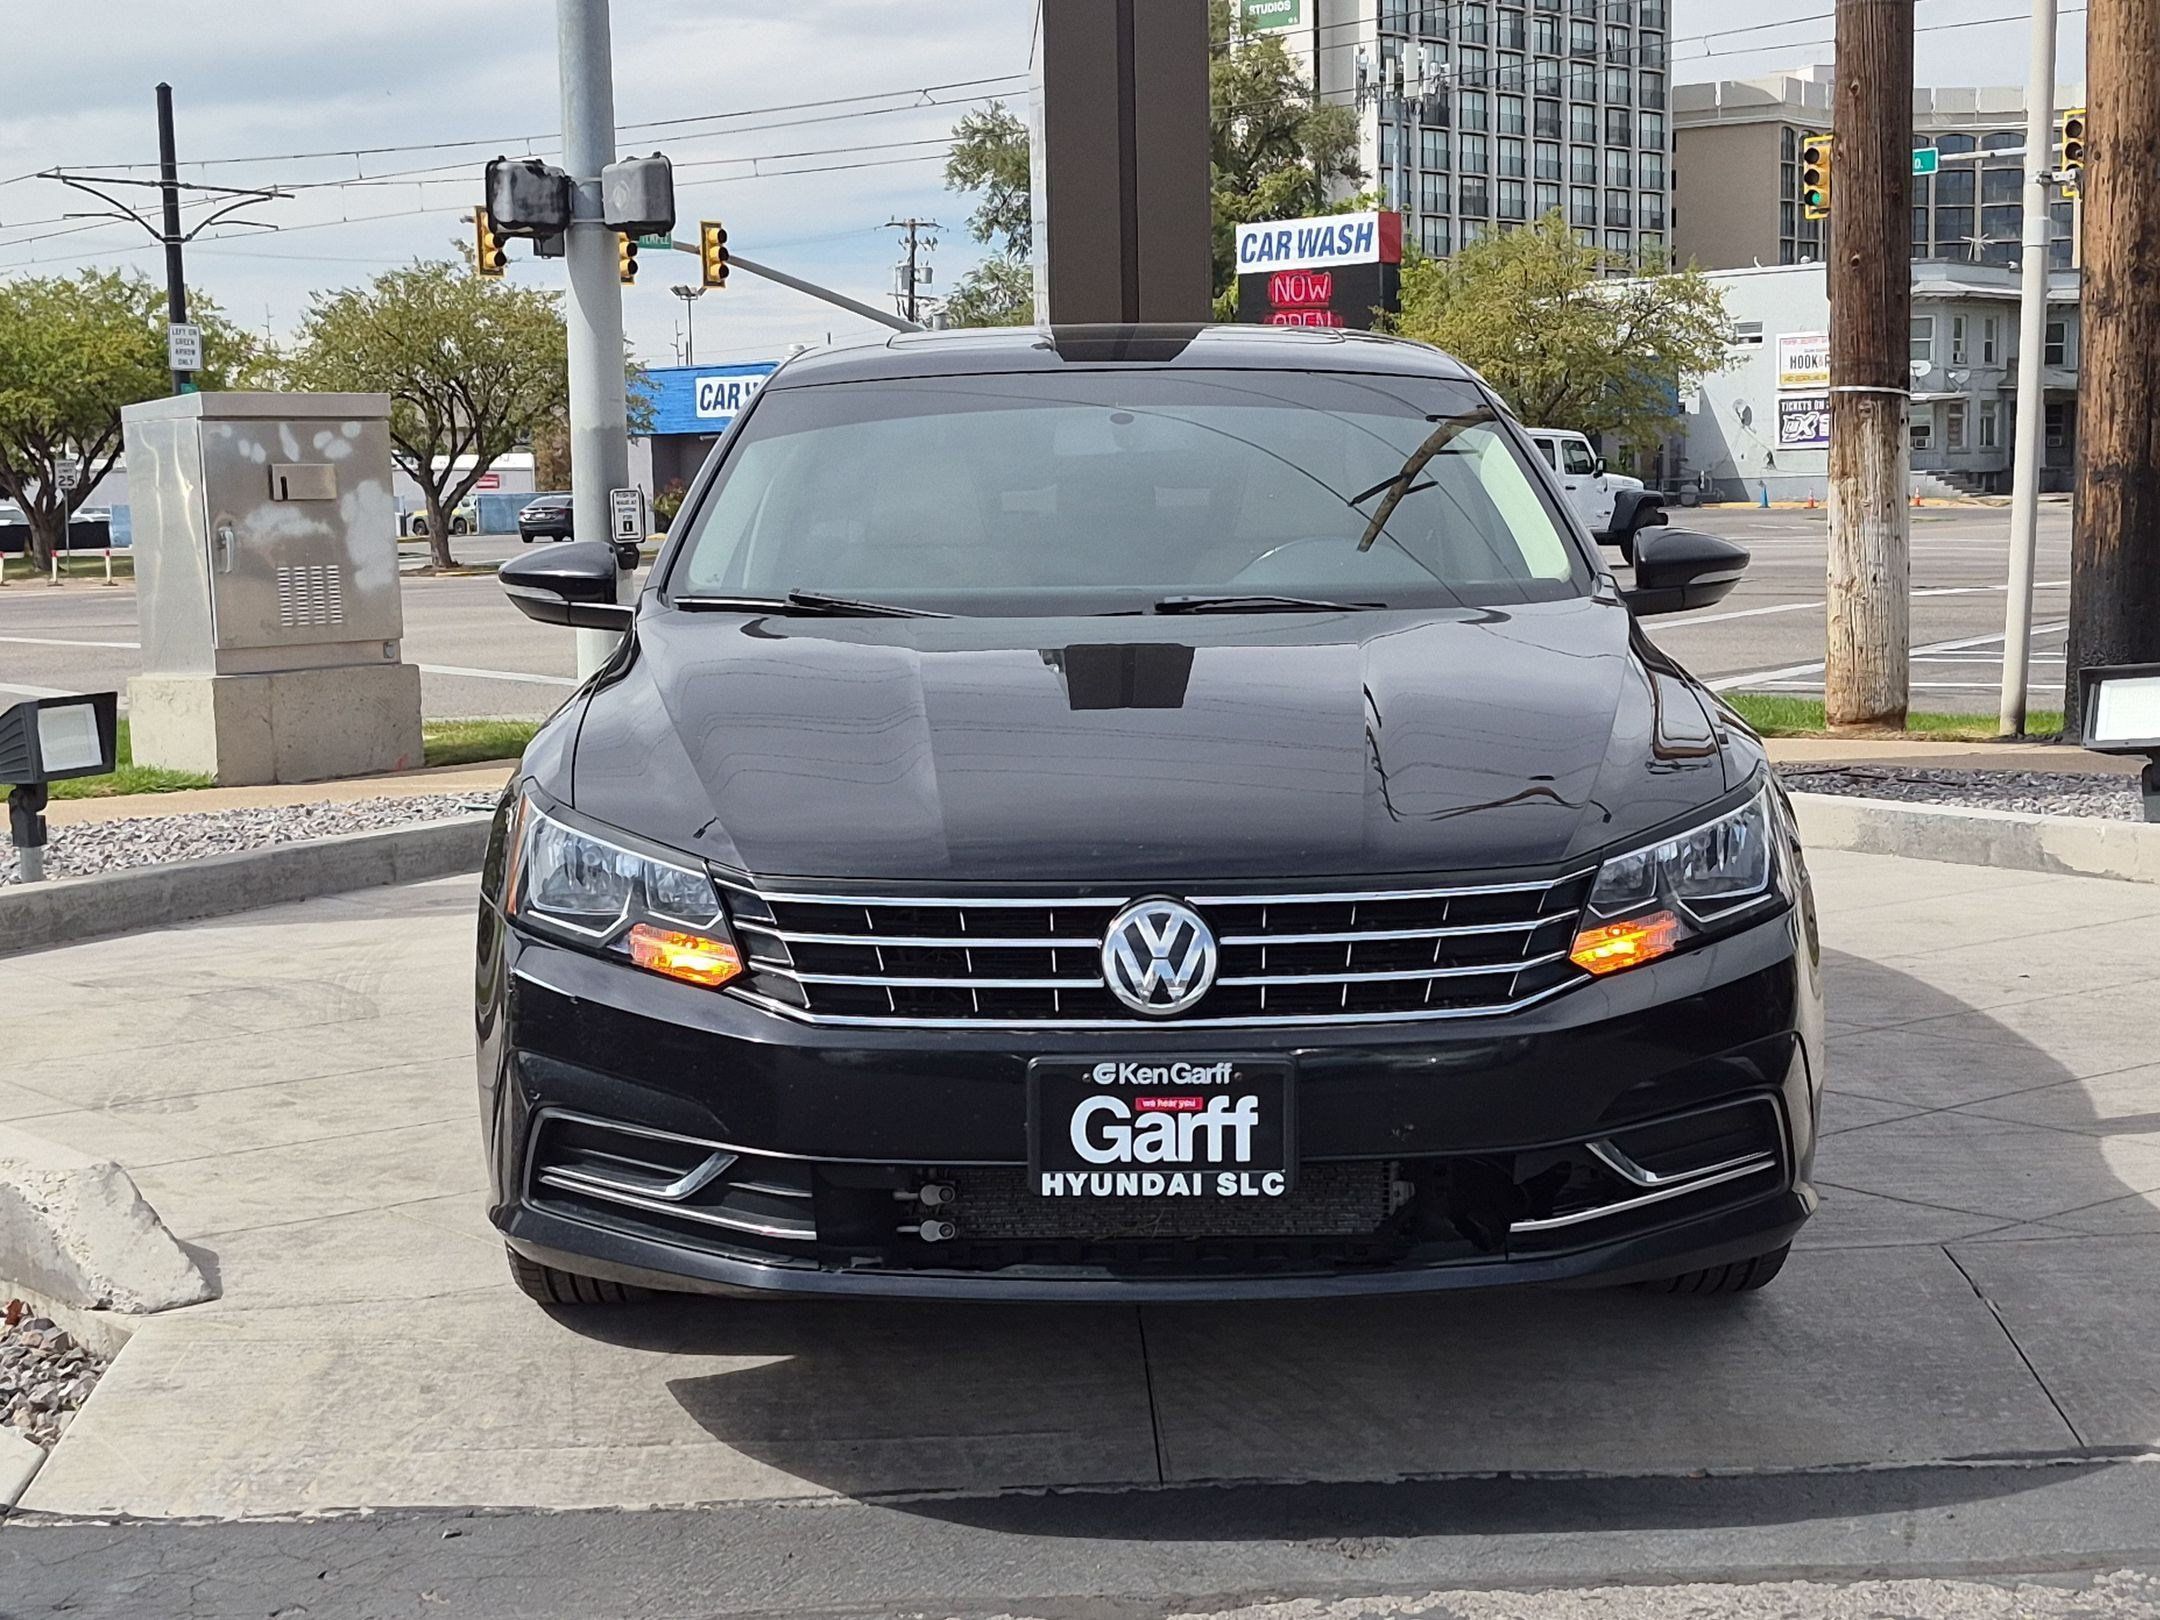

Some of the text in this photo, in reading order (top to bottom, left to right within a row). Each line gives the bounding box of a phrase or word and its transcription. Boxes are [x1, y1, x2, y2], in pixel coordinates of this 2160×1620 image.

[1249, 0, 1291, 17] STUDIOS
[1240, 221, 1374, 264] CAR WASH
[1273, 274, 1329, 303] NOW
[1789, 354, 1819, 370] HOOK
[699, 382, 741, 411] CAR
[58, 475, 75, 487] 25
[1118, 1062, 1169, 1085] Ken
[1170, 1062, 1233, 1085] Garff
[1069, 1094, 1259, 1165] Garff
[1041, 1171, 1286, 1197] HYUNDAI SLC
